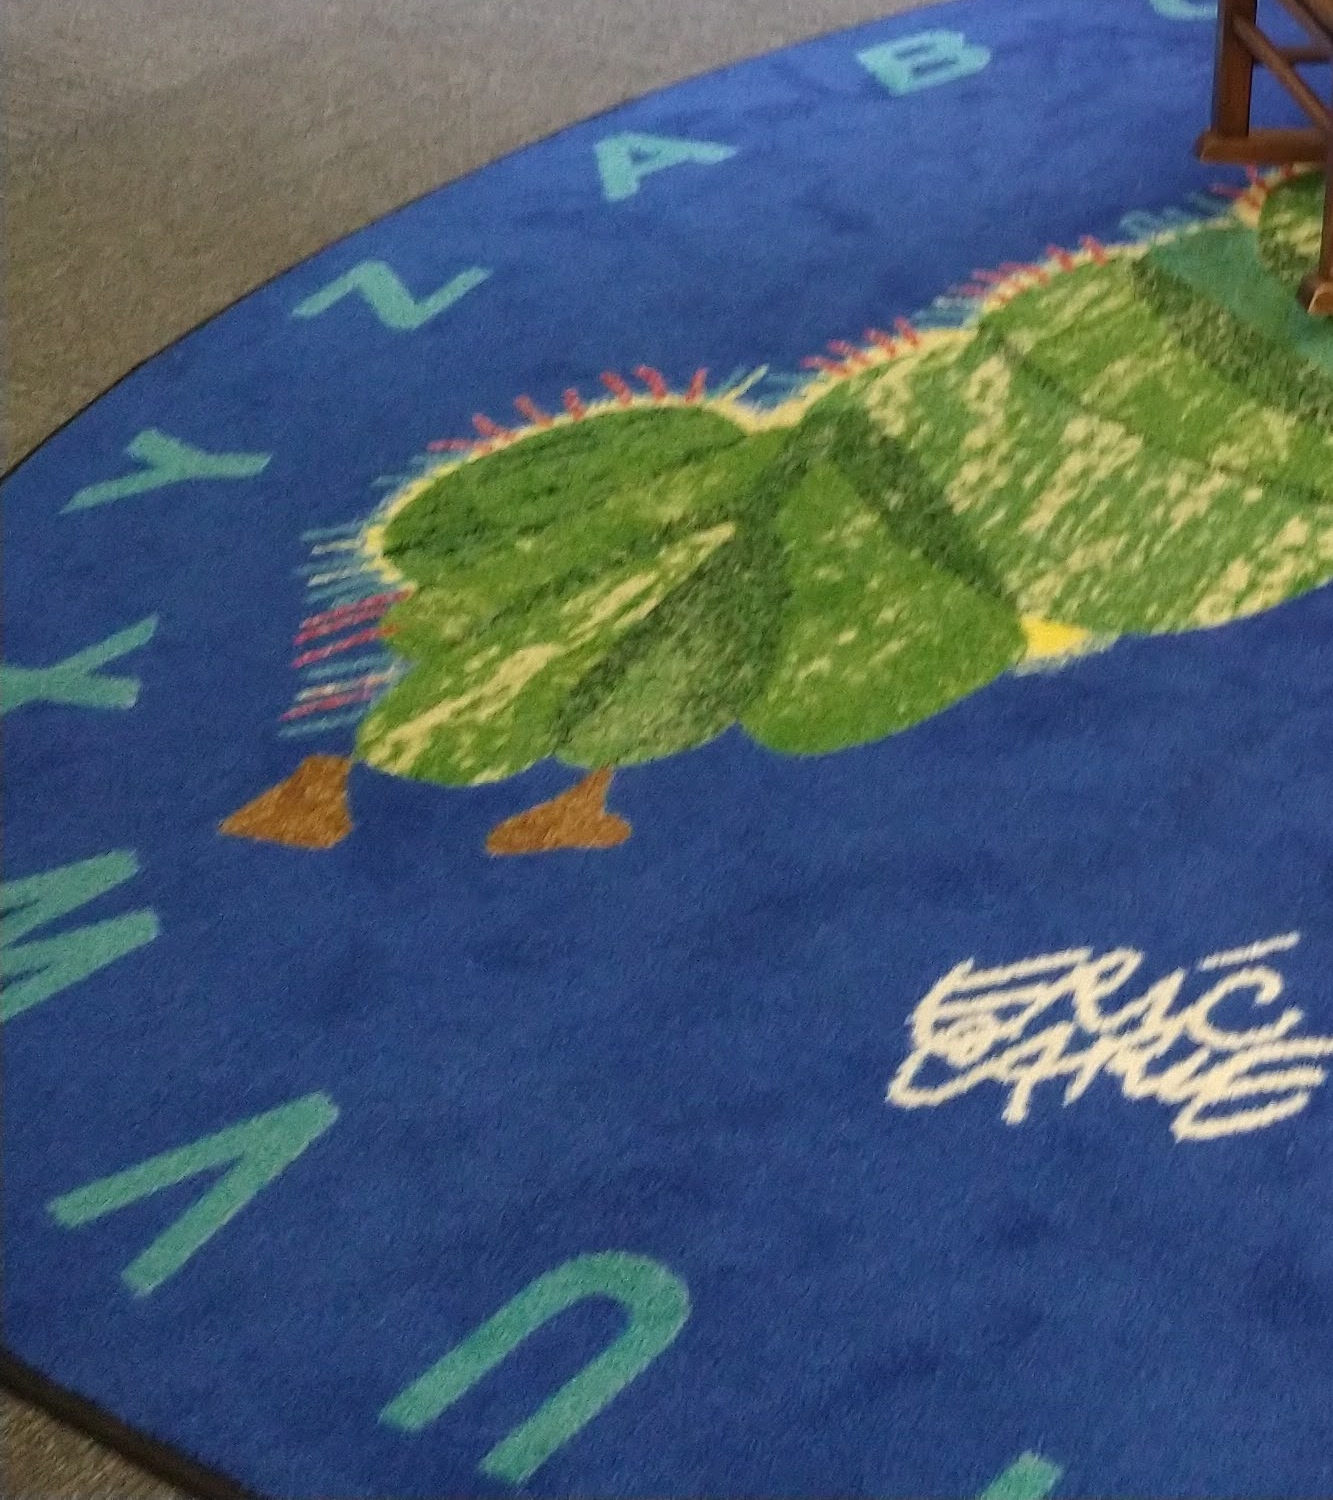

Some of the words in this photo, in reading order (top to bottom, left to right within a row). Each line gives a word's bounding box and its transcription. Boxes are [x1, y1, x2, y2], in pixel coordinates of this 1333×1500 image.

[858, 29, 990, 95] B
[593, 132, 738, 202] A
[291, 259, 491, 331] Z
[61, 428, 272, 514] Y
[47, 1091, 340, 1297] V
[379, 1249, 692, 1487] U
